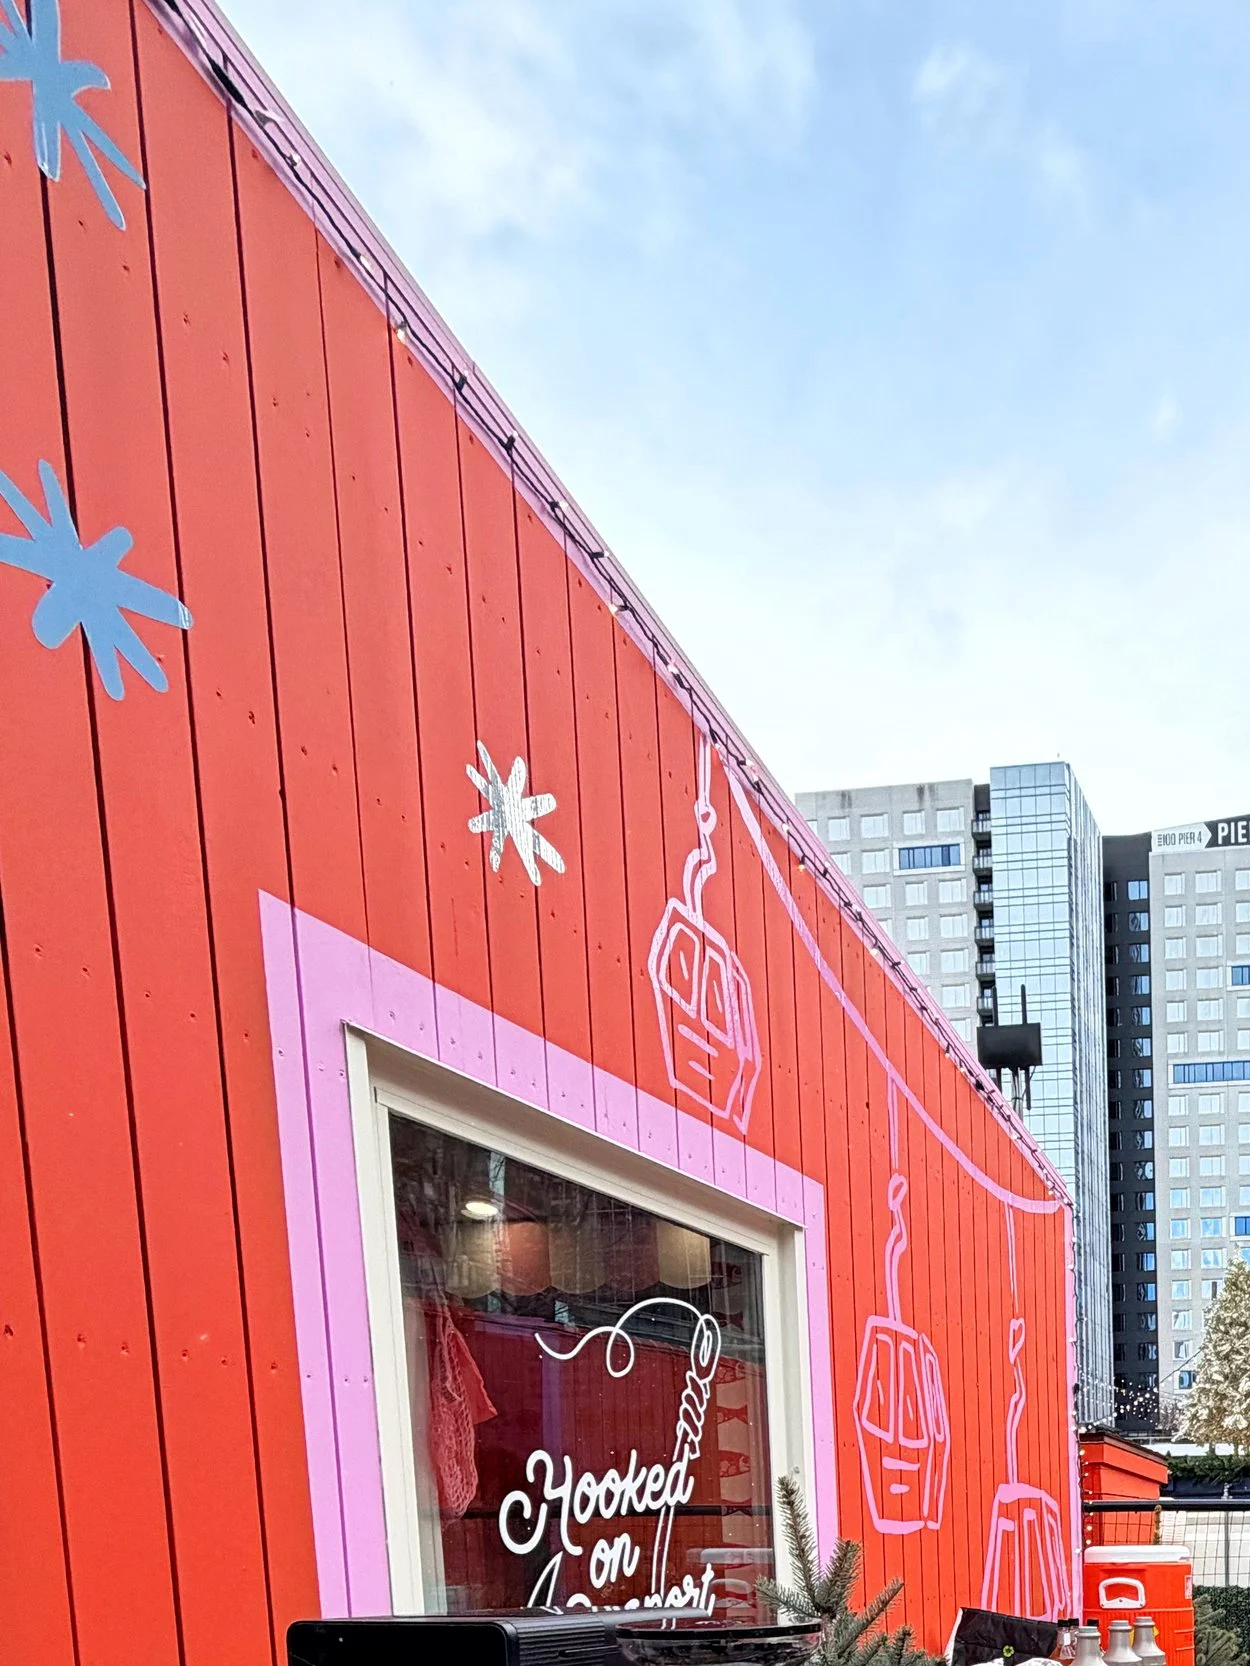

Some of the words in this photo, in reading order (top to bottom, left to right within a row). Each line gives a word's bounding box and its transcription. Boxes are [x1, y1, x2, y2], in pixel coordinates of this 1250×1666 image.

[1178, 831, 1196, 845] PIER
[1196, 831, 1202, 843] 4
[498, 1443, 695, 1556] Hooked
[589, 1532, 640, 1589] on
